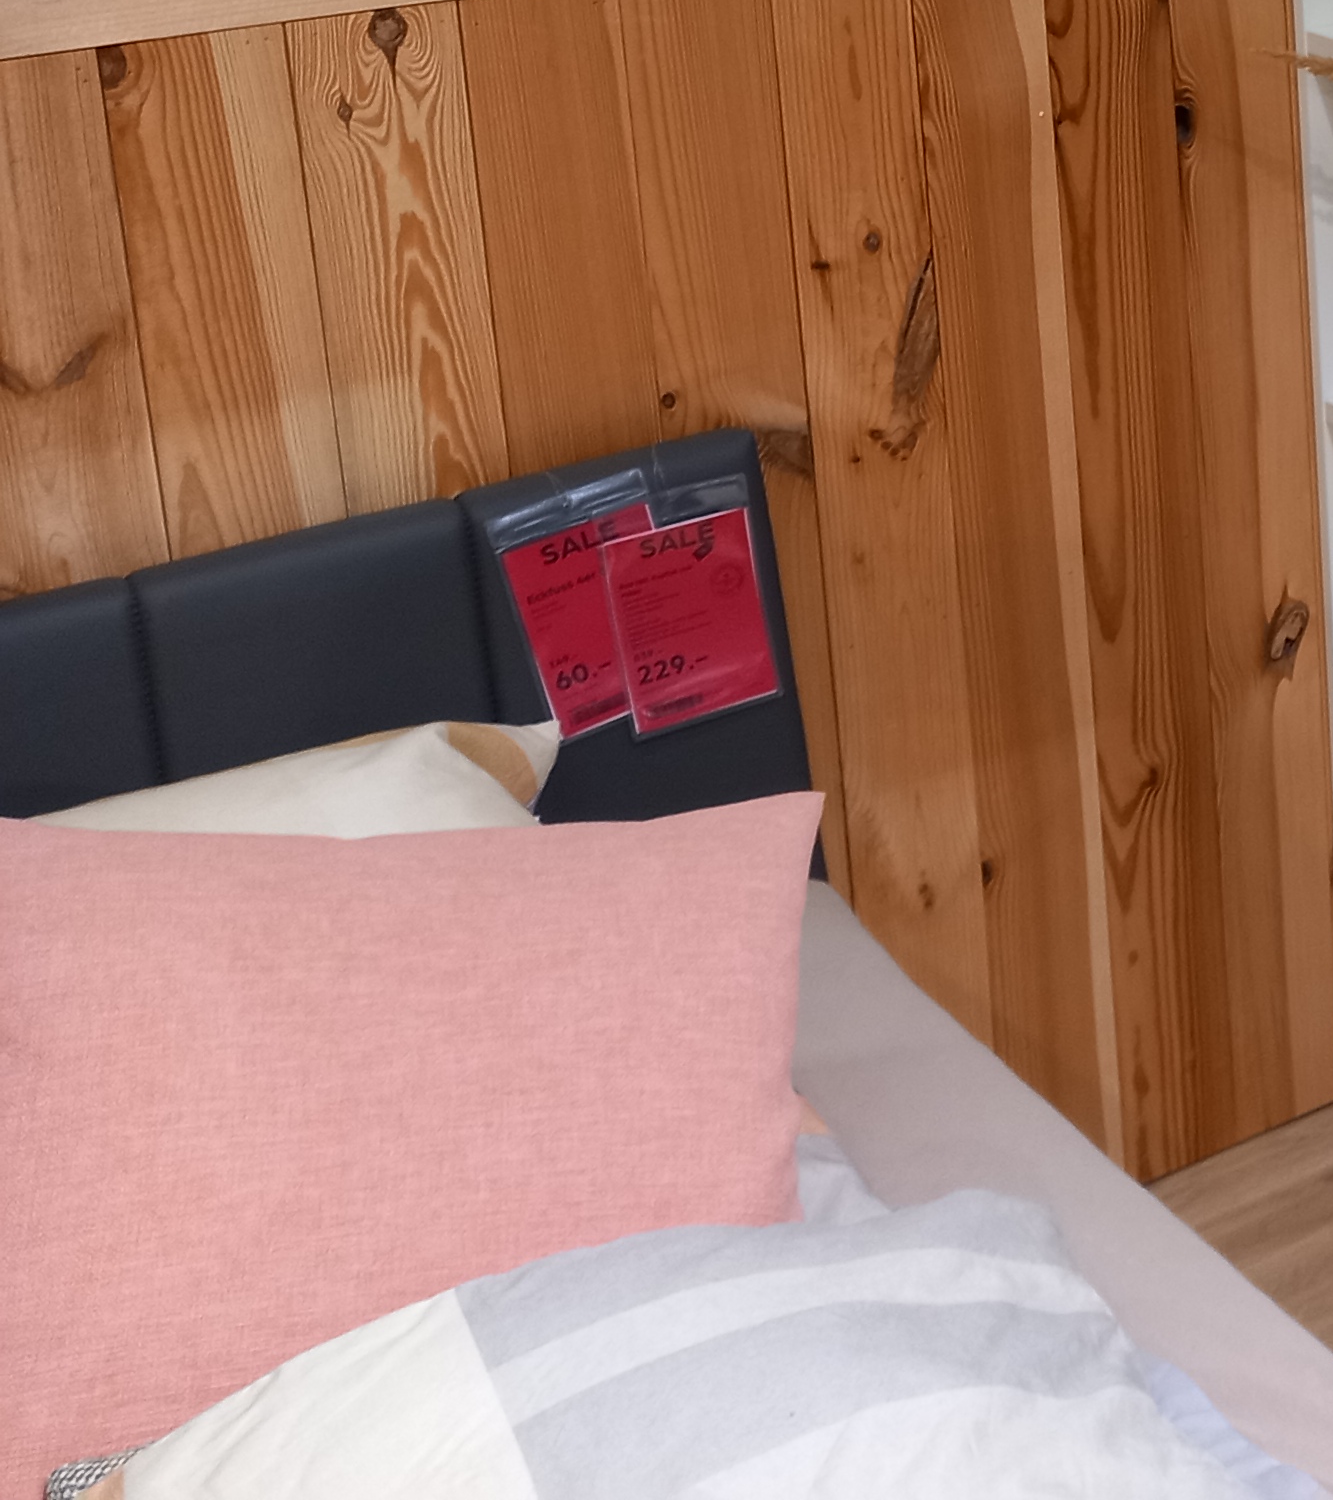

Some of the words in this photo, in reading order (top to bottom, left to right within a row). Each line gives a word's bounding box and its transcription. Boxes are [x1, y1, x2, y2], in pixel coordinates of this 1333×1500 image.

[541, 520, 619, 565] SALE
[640, 520, 716, 559] SALE
[556, 661, 612, 690] 60.-
[637, 654, 708, 686] 229.-
